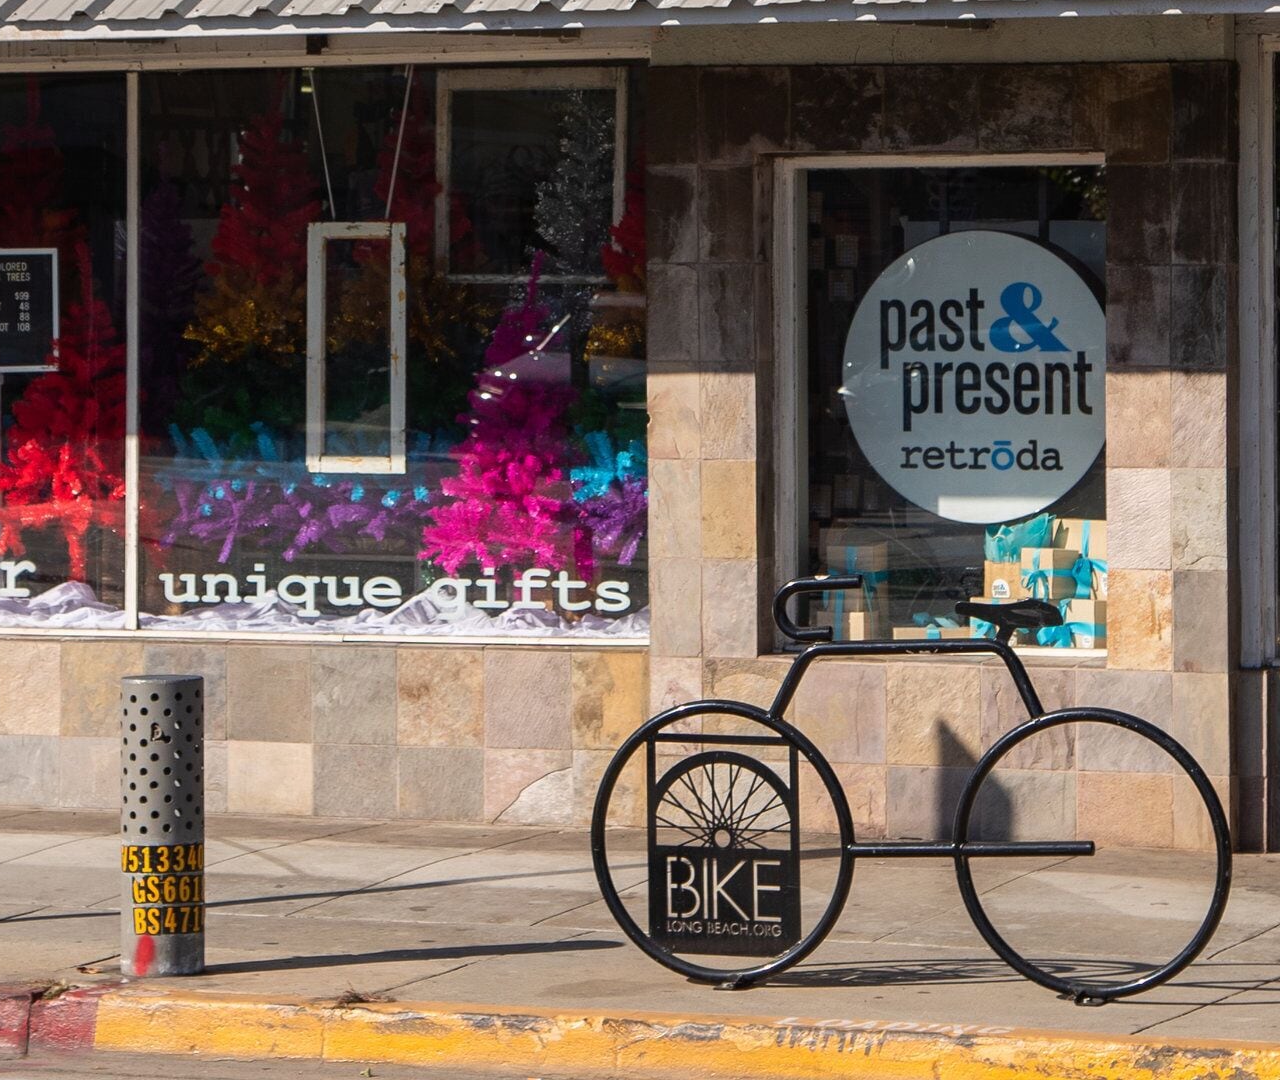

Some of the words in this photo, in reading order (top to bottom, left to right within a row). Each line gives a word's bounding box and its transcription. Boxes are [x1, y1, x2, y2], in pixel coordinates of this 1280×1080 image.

[7, 272, 31, 282] TREES
[14, 291, 29, 300] $99
[19, 301, 30, 310] 48
[17, 323, 30, 331] 108
[880, 288, 984, 369] past
[989, 282, 1072, 353] &
[902, 351, 1093, 432] present
[158, 563, 402, 618] unique
[429, 567, 632, 616] gifts
[666, 856, 782, 923] BIKE
[667, 920, 703, 933] LONG
[707, 922, 782, 937] BEACH.ORG
